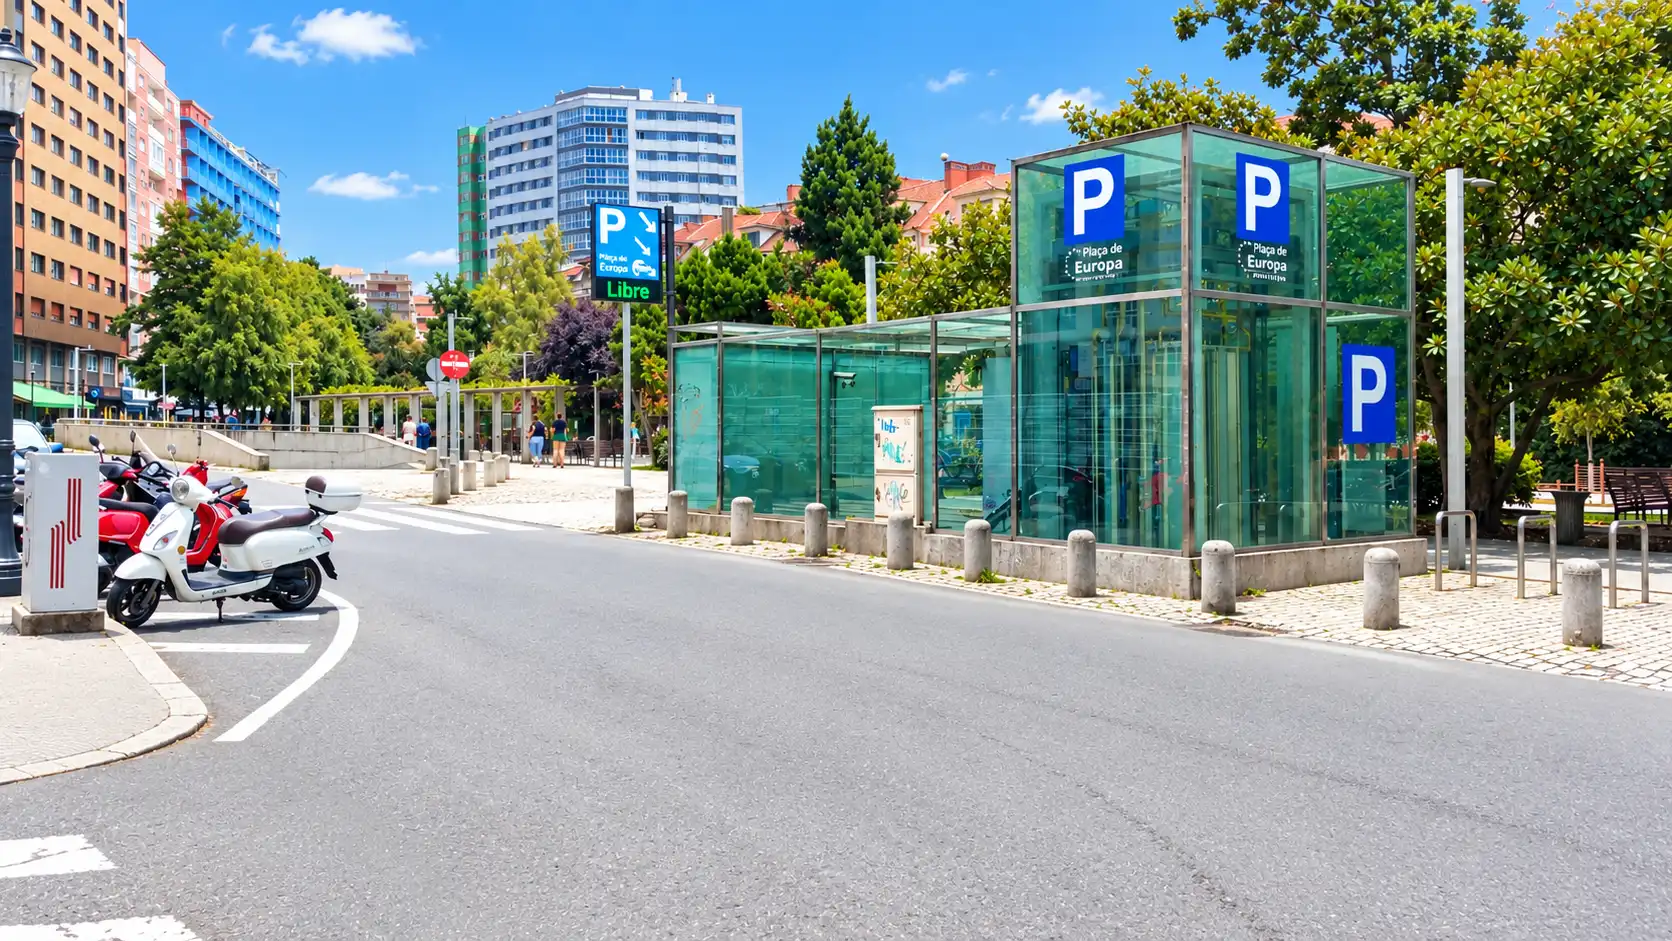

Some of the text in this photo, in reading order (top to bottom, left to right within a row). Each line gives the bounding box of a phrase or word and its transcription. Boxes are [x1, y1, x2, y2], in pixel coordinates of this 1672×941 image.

[1073, 167, 1114, 236] P
[1245, 162, 1281, 231] P
[600, 207, 626, 244] P
[1082, 242, 1123, 259] Plaça de
[1253, 242, 1287, 257] Plaça de
[1075, 259, 1123, 275] Europa
[1247, 254, 1287, 274] Europa
[607, 281, 650, 299] Libre
[1352, 354, 1387, 432] P
